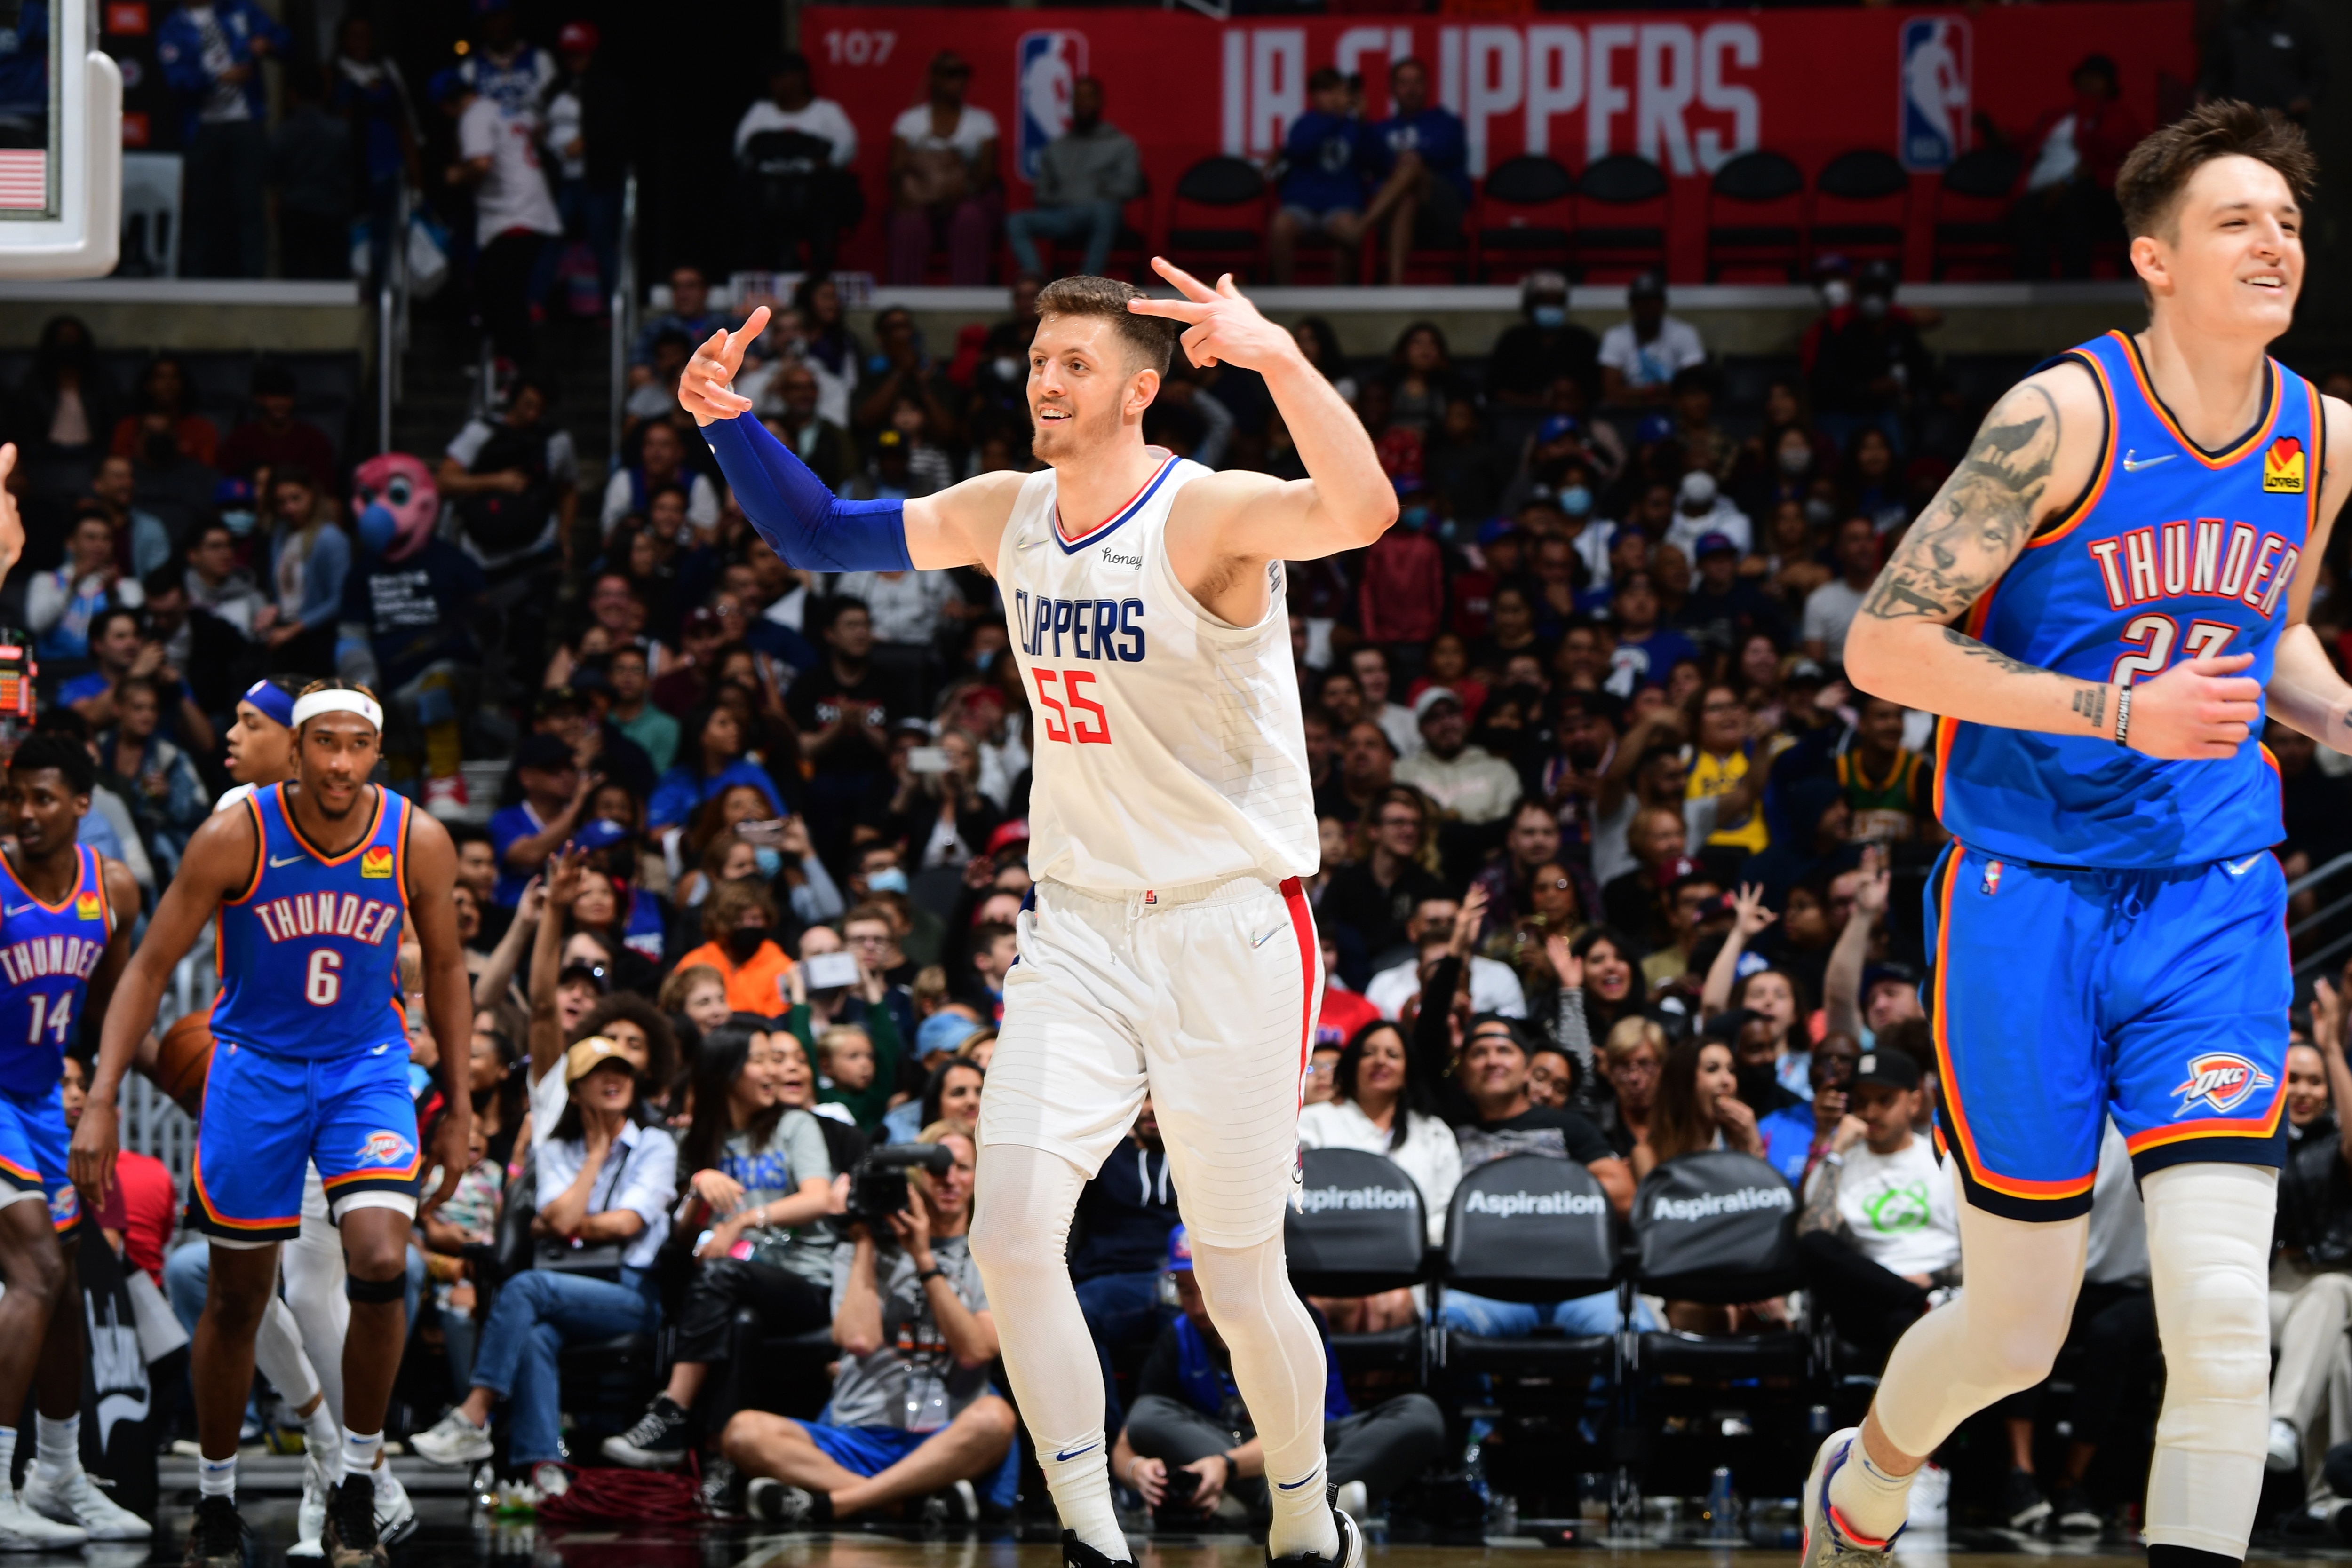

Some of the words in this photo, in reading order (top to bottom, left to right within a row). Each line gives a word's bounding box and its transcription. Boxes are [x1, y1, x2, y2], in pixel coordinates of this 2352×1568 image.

[823, 27, 898, 67] 107
[1102, 547, 1143, 570] honey
[2088, 518, 2300, 620] THUNDER
[1015, 588, 1145, 662] CLIPPERS
[1031, 667, 1112, 745] 55
[254, 891, 398, 946] THUNDER
[305, 948, 343, 1007] 6
[28, 991, 73, 1045] 14
[2187, 1067, 2246, 1101] OKC
[1289, 1185, 1415, 1213] spiration
[1465, 1189, 1605, 1218] Aspiration
[1653, 1186, 1792, 1221] Aspiration
